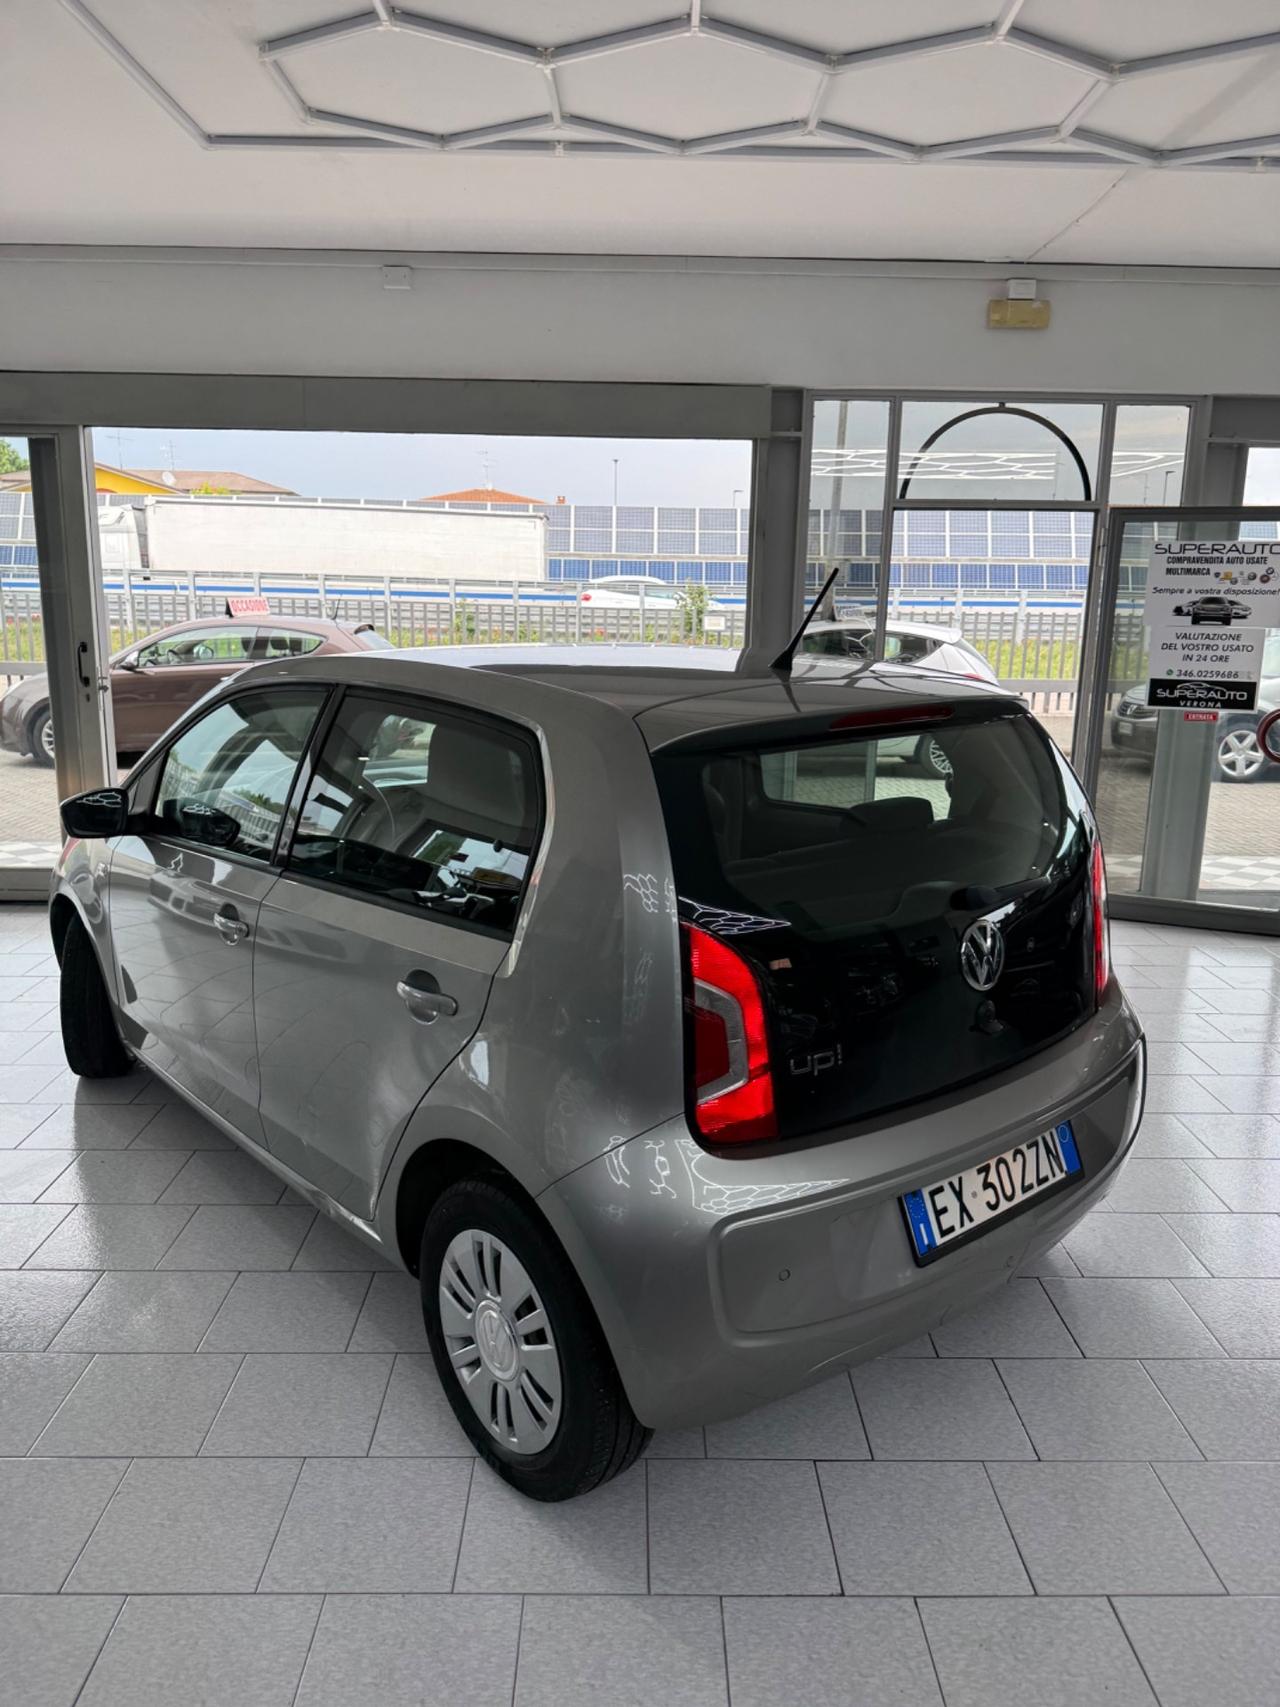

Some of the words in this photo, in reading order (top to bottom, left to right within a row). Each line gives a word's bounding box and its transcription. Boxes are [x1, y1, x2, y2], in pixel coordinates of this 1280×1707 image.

[1167, 556, 1224, 564] COMPRAVENDITA
[1225, 557, 1244, 565] AUTO
[1246, 557, 1268, 565] USATE
[1165, 567, 1210, 576] MULTIMARCA
[1152, 586, 1185, 596] Sempre
[1195, 587, 1221, 595] vostra
[1176, 632, 1242, 641] VALUTAZIONE
[1161, 642, 1178, 651] DEL
[1181, 643, 1219, 652] VOSTRO
[1222, 644, 1254, 653] USATO
[1182, 654, 1193, 662] IN
[1196, 654, 1207, 662] 24
[1210, 654, 1230, 663] ORE
[1176, 669, 1239, 679] 346.0259686
[1156, 688, 1247, 700] SUPERAUTO
[1180, 700, 1222, 708] VERONA
